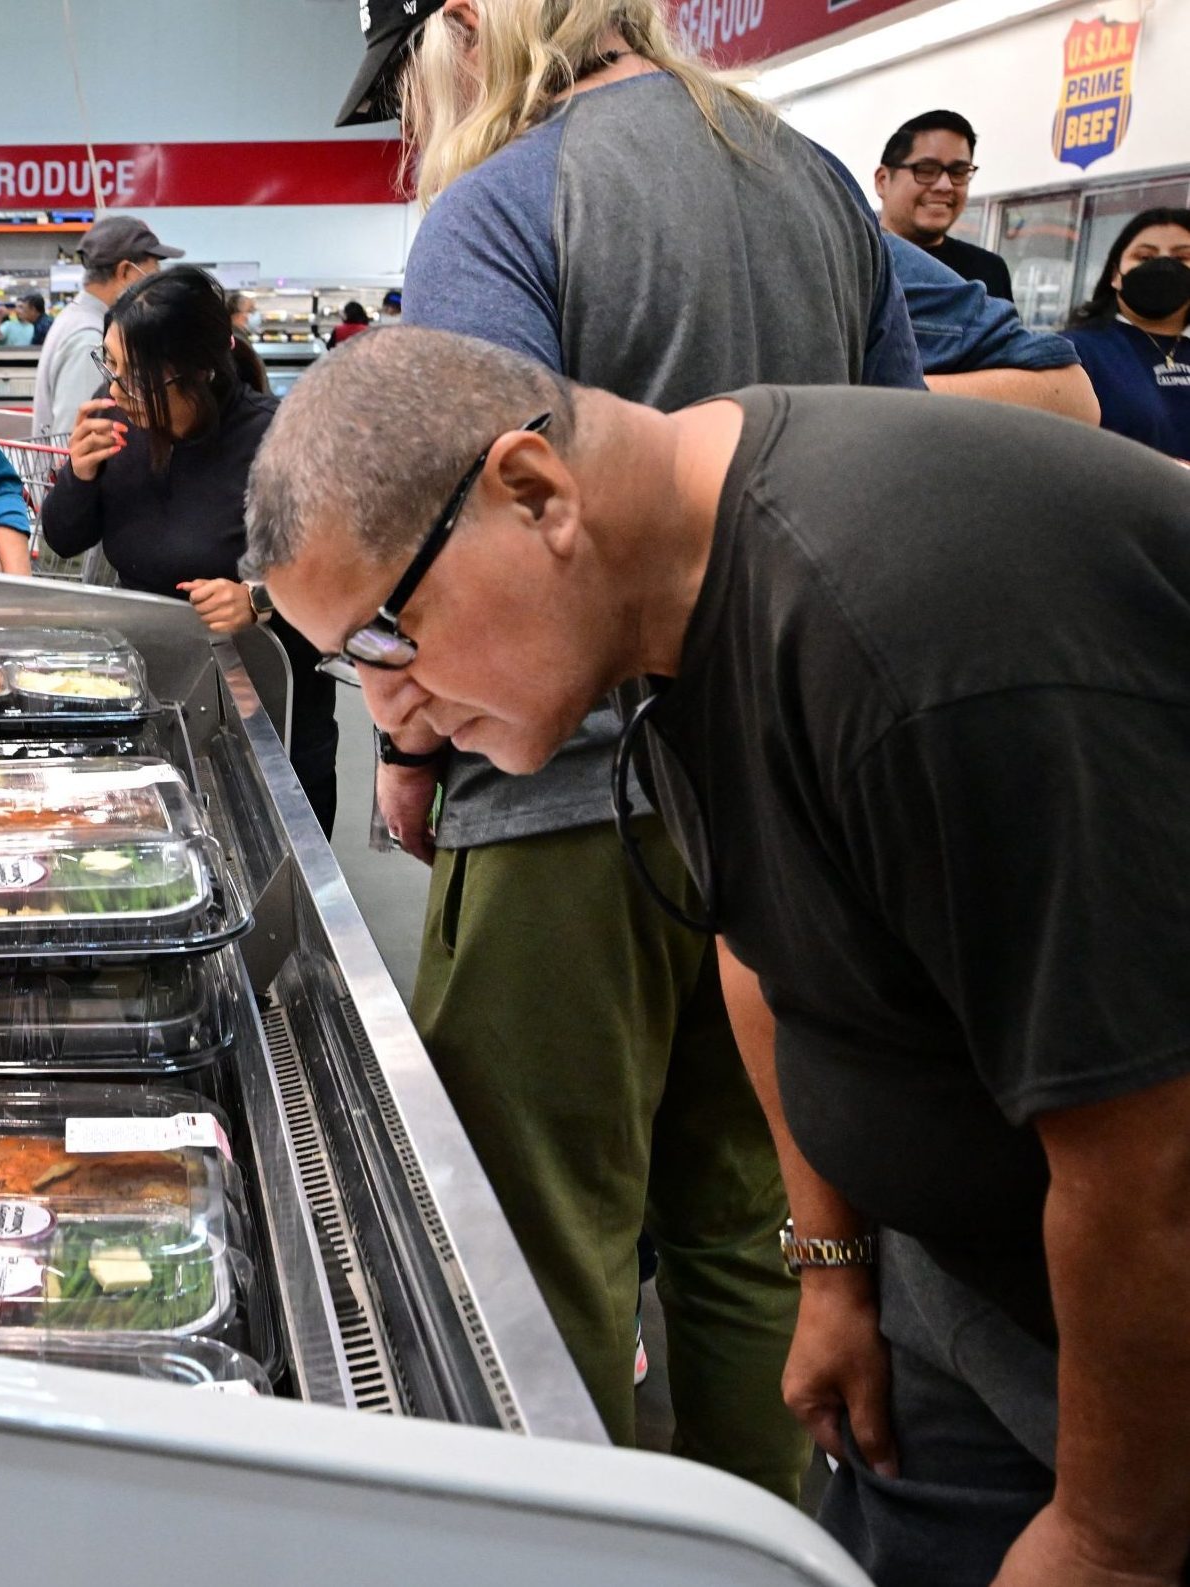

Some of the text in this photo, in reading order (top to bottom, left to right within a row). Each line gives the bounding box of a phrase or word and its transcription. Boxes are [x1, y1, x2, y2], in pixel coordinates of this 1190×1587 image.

[678, 0, 764, 55] SEAFOOD
[1067, 25, 1132, 70] U.S.D.A.
[1065, 67, 1125, 102] PRIME
[1064, 107, 1116, 149] BEEF
